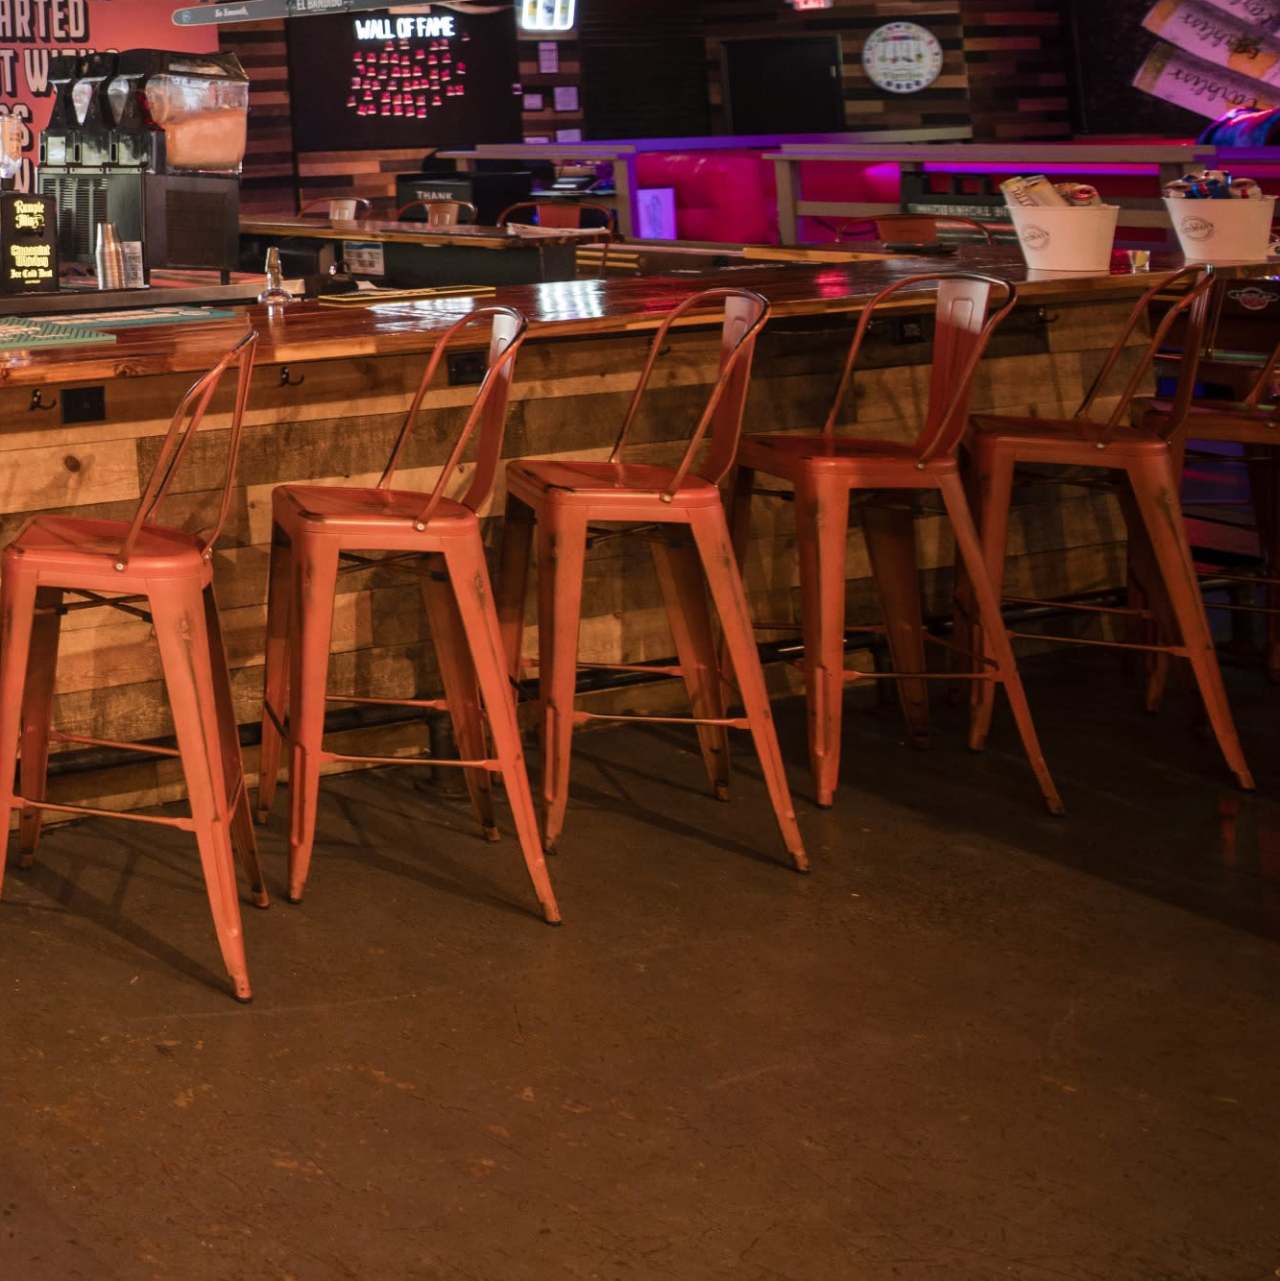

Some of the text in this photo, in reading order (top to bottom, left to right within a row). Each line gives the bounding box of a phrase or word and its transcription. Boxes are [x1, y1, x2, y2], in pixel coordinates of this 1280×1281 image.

[354, 16, 456, 41] WALL OF FAME
[415, 190, 454, 201] THANK
